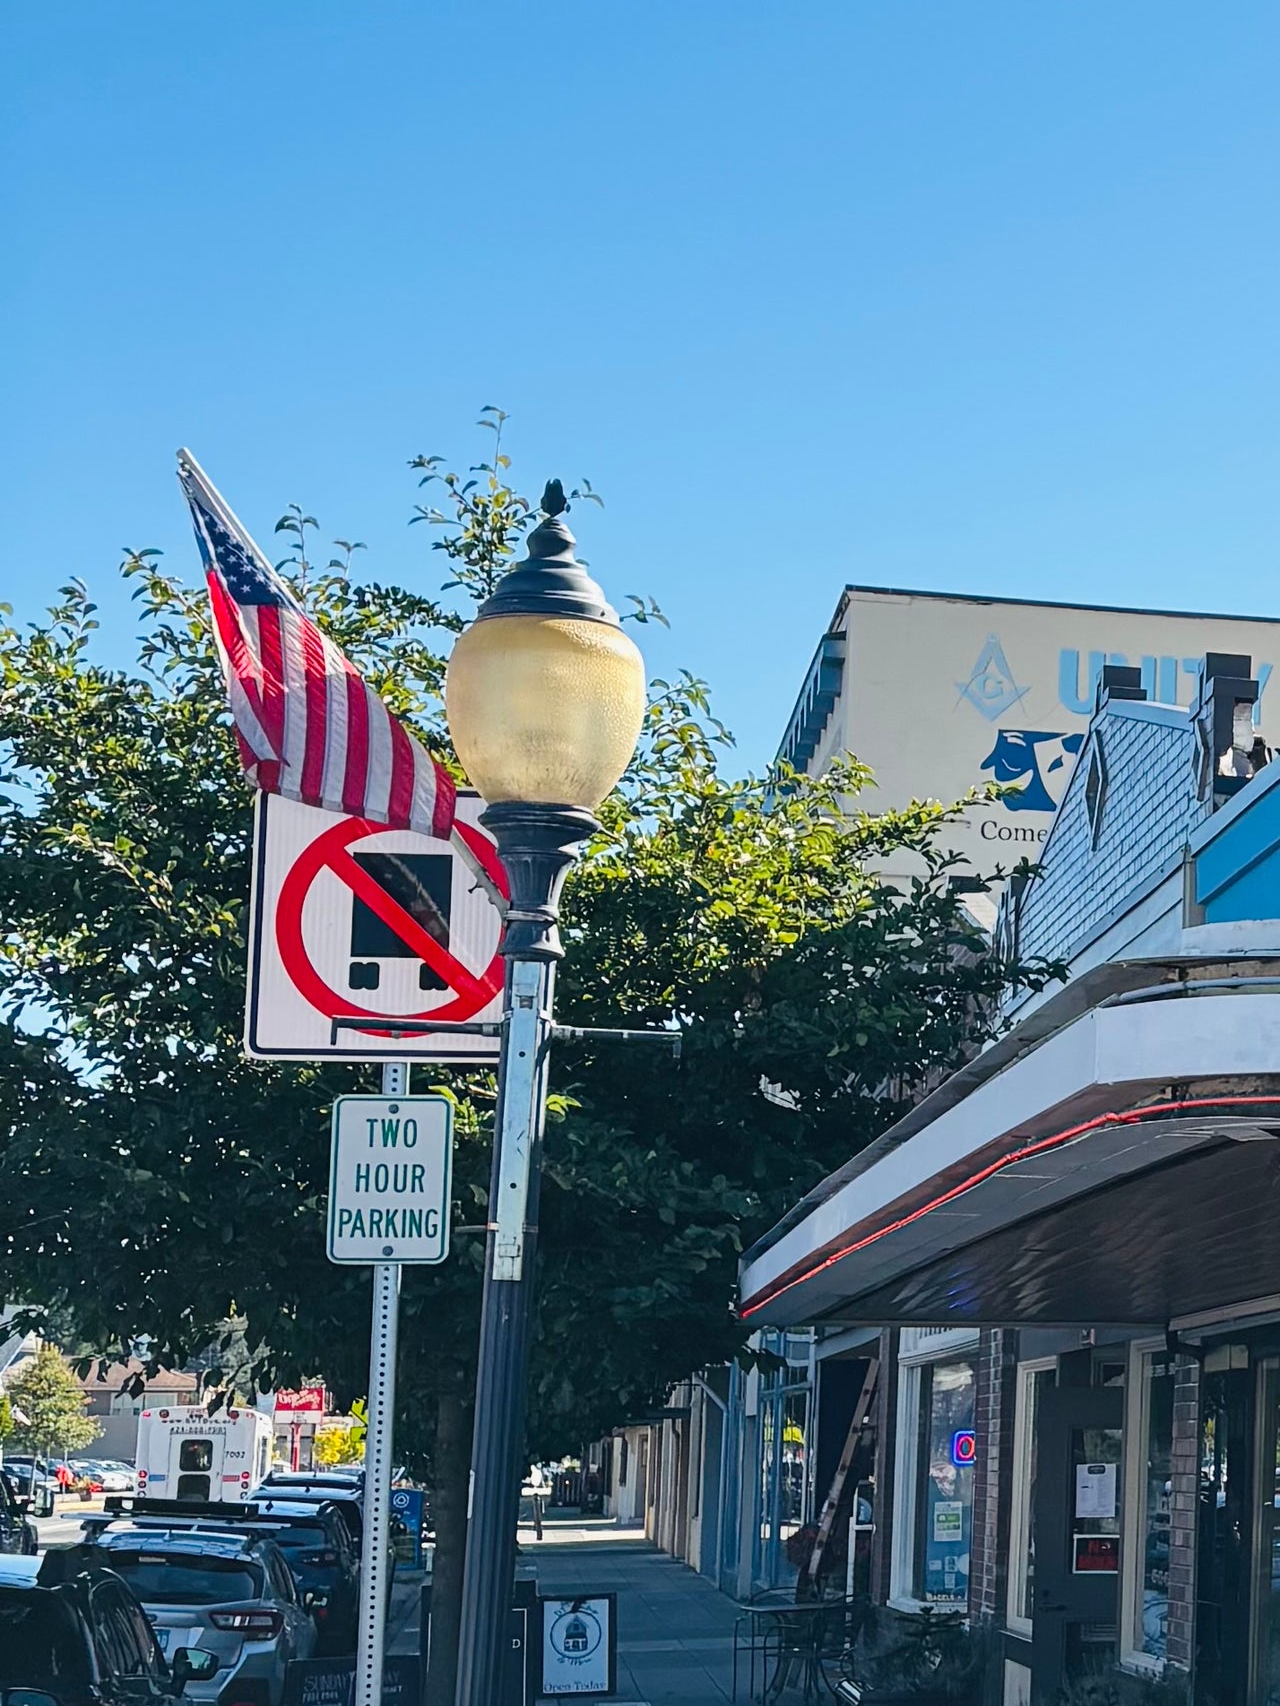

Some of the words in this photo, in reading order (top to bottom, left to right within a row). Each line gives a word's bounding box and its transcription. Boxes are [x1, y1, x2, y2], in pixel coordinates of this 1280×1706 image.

[365, 1119, 418, 1149] TWO
[354, 1163, 426, 1194] HOUR
[338, 1207, 440, 1239] PARKING
